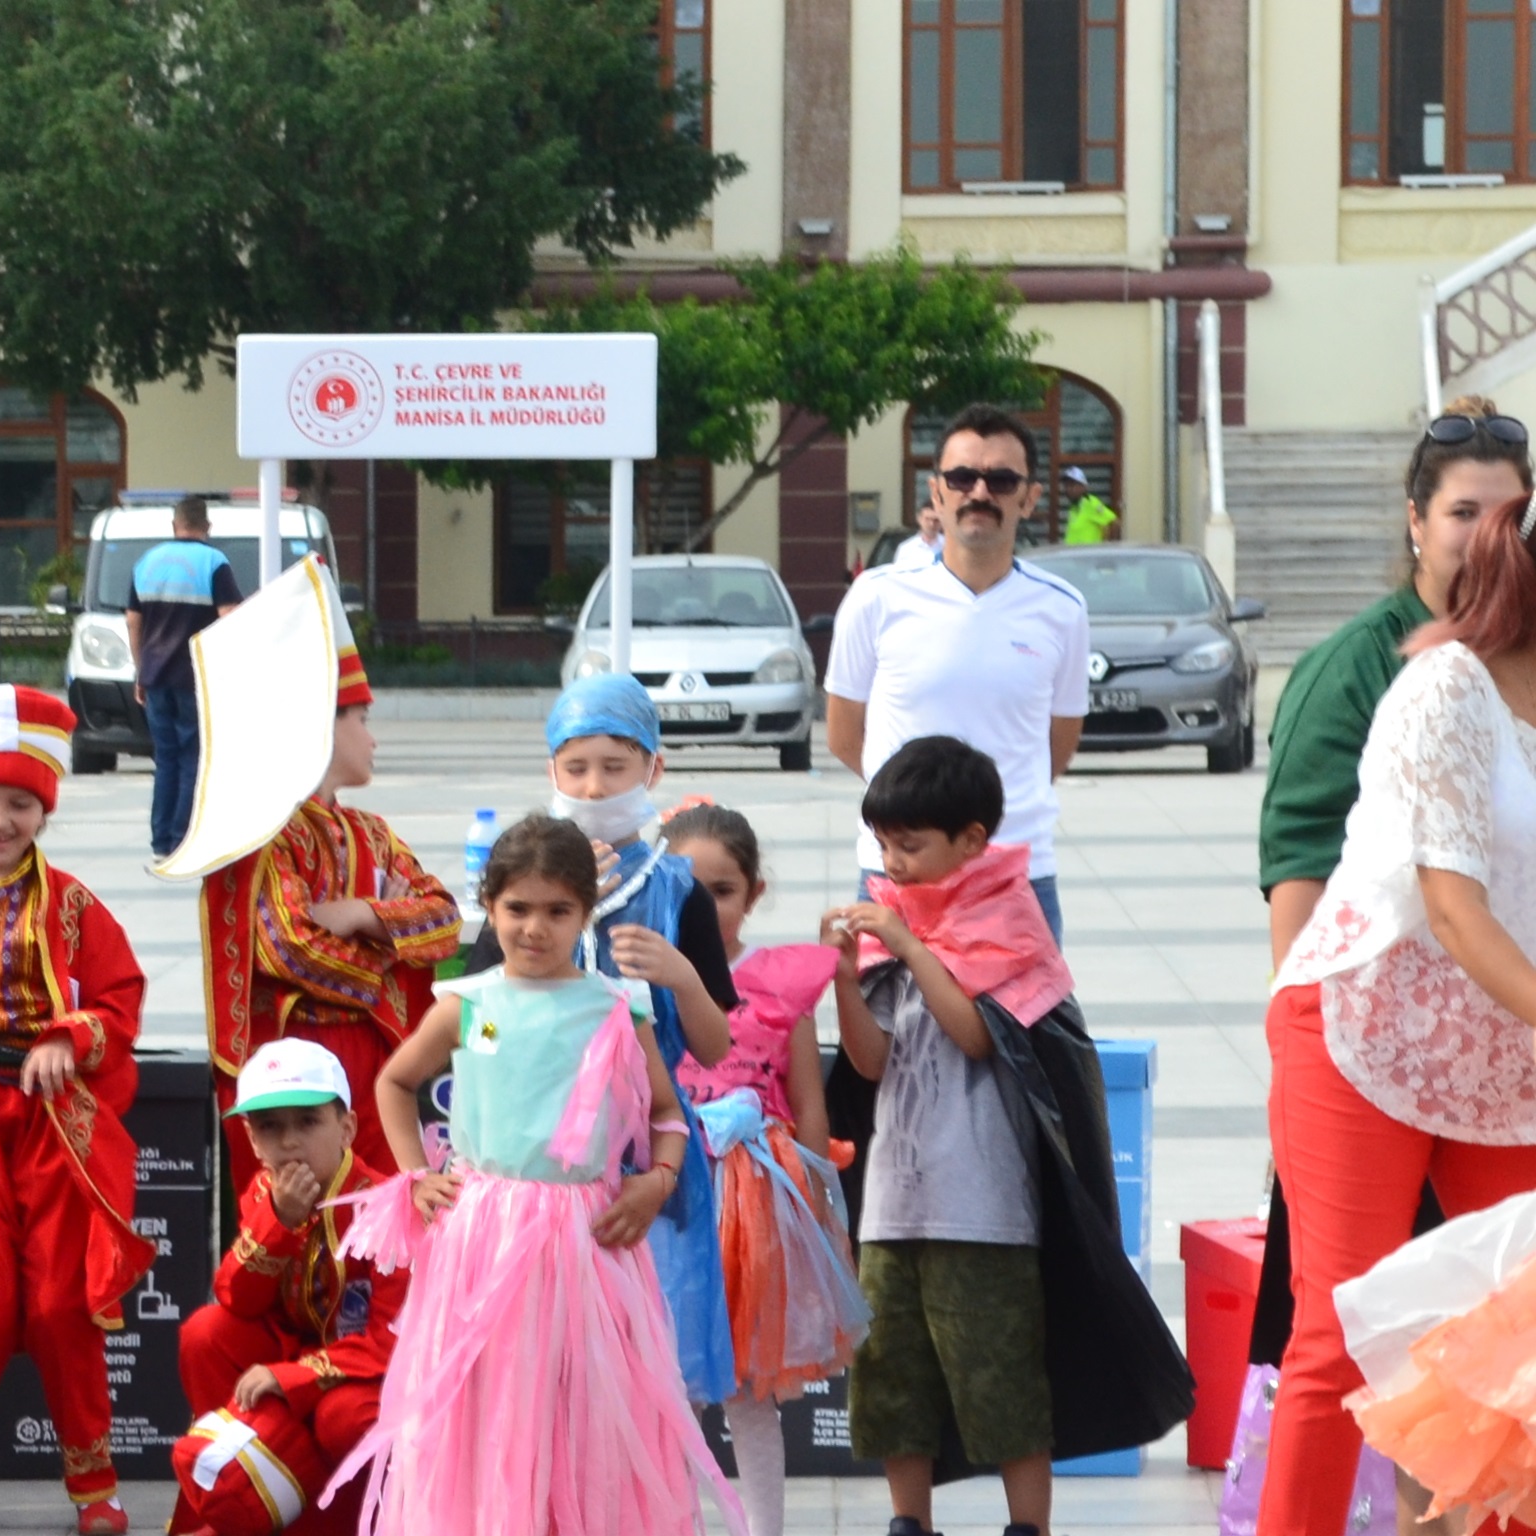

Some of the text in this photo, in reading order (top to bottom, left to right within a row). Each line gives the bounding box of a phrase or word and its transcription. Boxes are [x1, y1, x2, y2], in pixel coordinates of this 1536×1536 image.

[394, 363, 522, 384] T.C. ÇEVRE VE
[394, 381, 606, 407] ŞEHİRCİLİK BAKANLIĞI
[394, 406, 606, 426] MANİSA İL MÜDÜRLÜĞÜ
